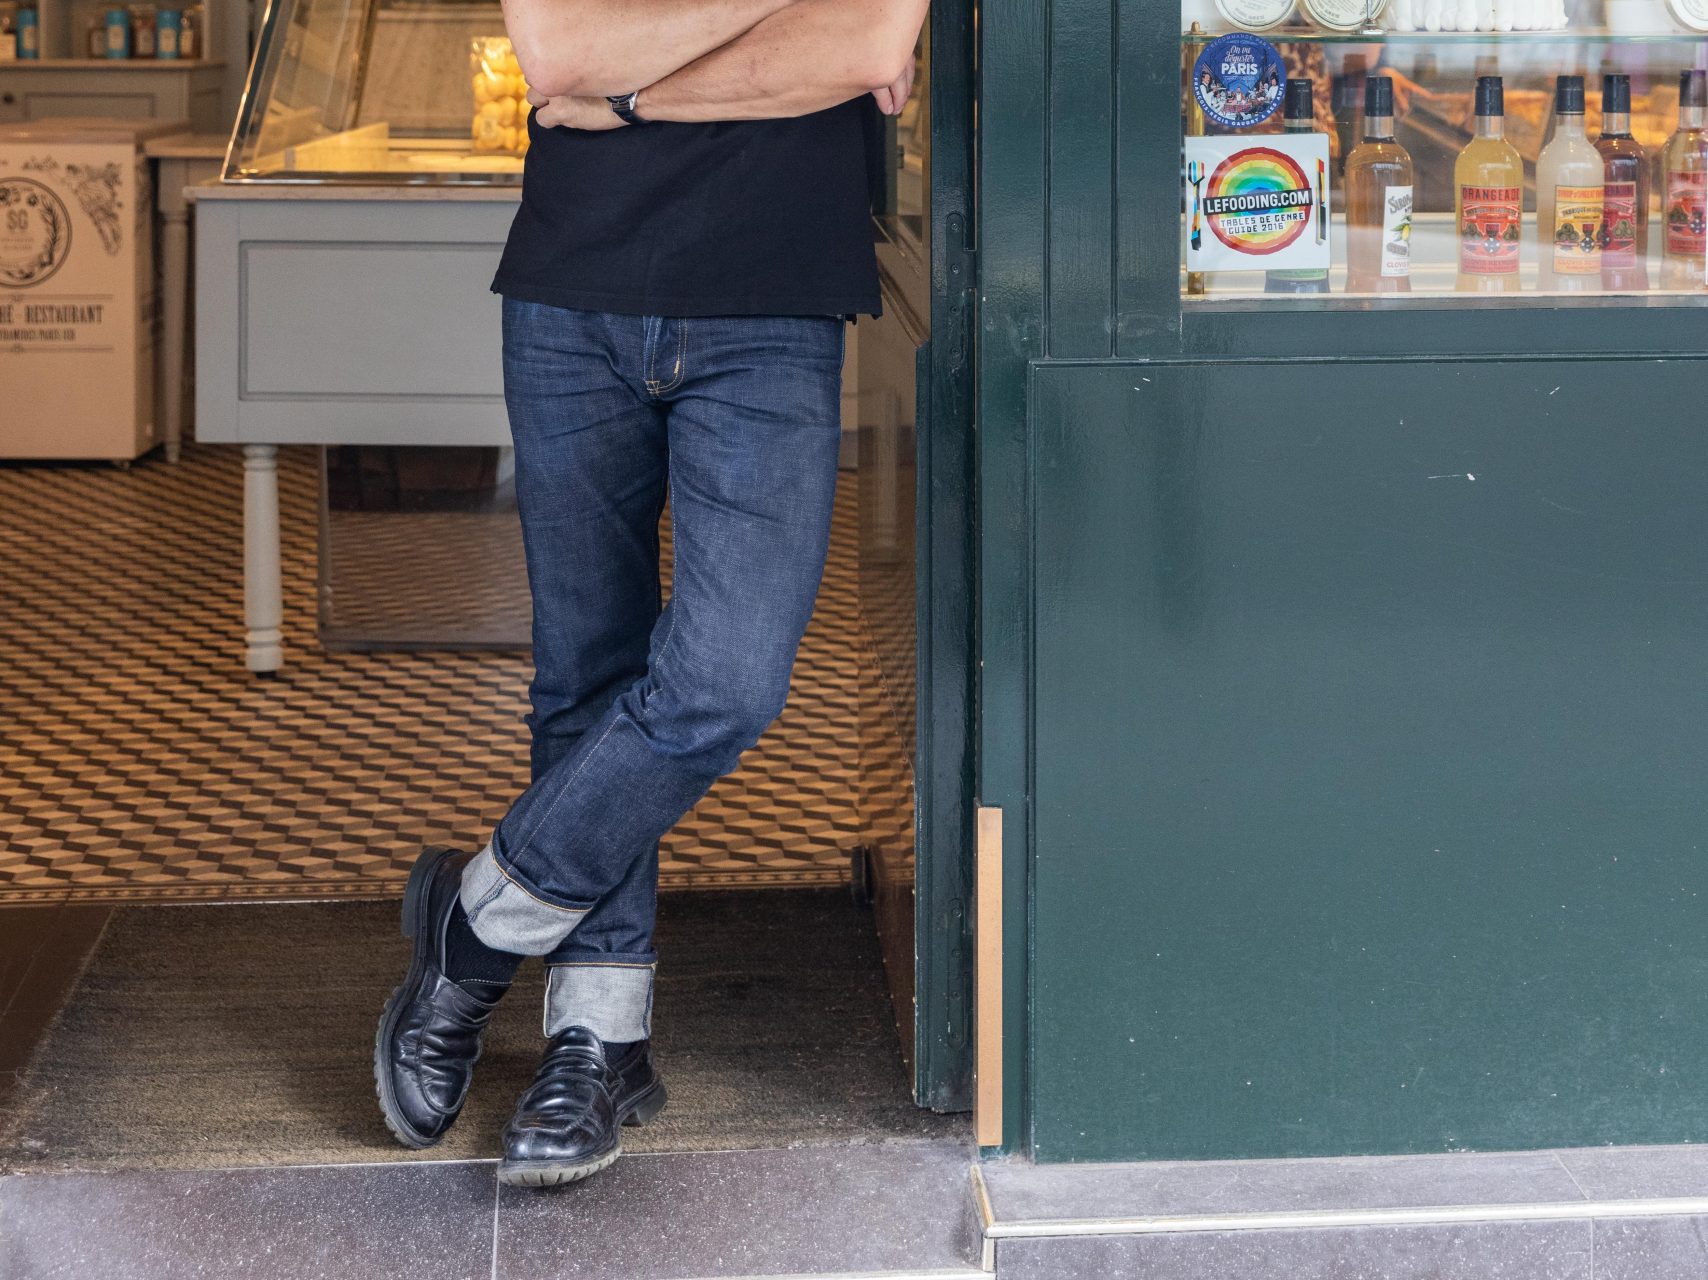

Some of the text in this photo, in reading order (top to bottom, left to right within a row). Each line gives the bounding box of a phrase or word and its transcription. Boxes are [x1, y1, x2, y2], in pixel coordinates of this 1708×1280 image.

[1221, 63, 1258, 75] PARIS
[1206, 190, 1310, 213] LEFOODING.COM
[6, 209, 29, 230] SG
[1221, 217, 1256, 227] TABLES
[1275, 212, 1304, 222] GENRE
[1228, 223, 1284, 234] GUIDE 2016
[25, 304, 104, 324] RESTAURANT
